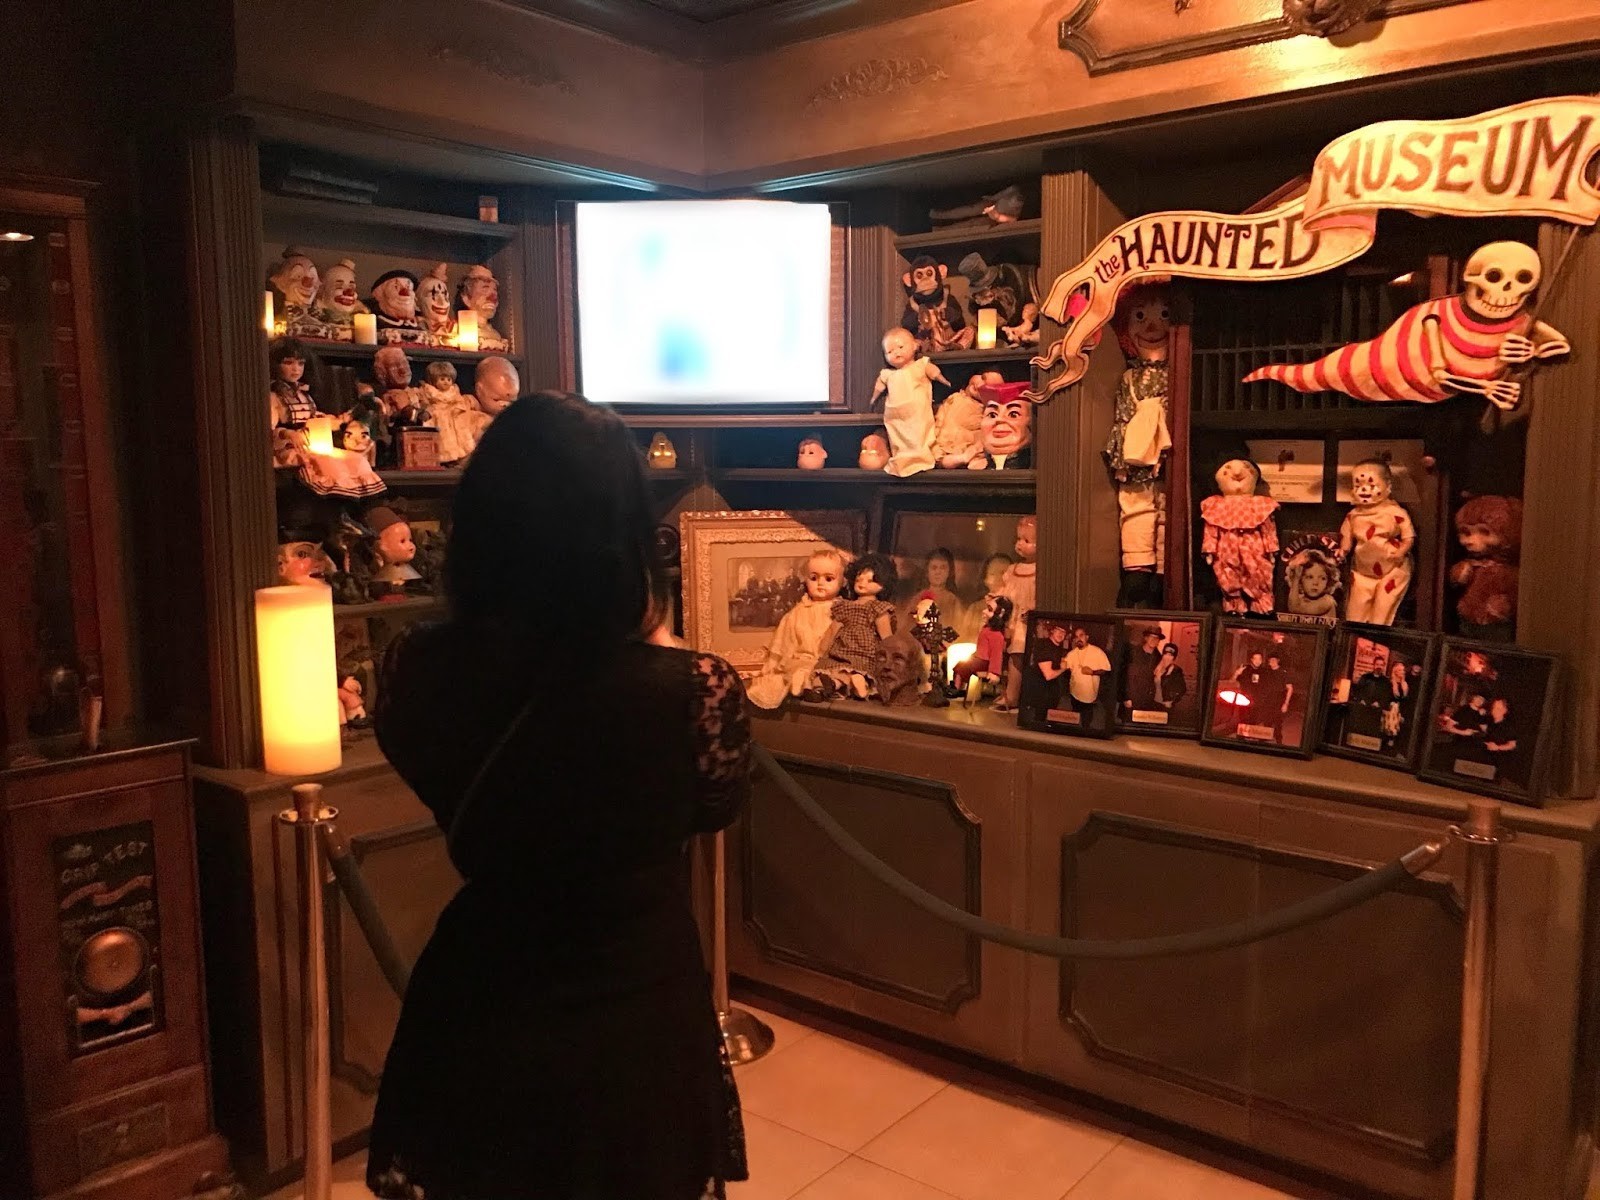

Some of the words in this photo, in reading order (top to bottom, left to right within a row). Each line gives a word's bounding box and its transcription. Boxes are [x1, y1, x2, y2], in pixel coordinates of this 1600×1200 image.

[1094, 253, 1120, 284] the
[1112, 216, 1322, 275] HAUNTED
[1317, 114, 1593, 203] MUSEUM
